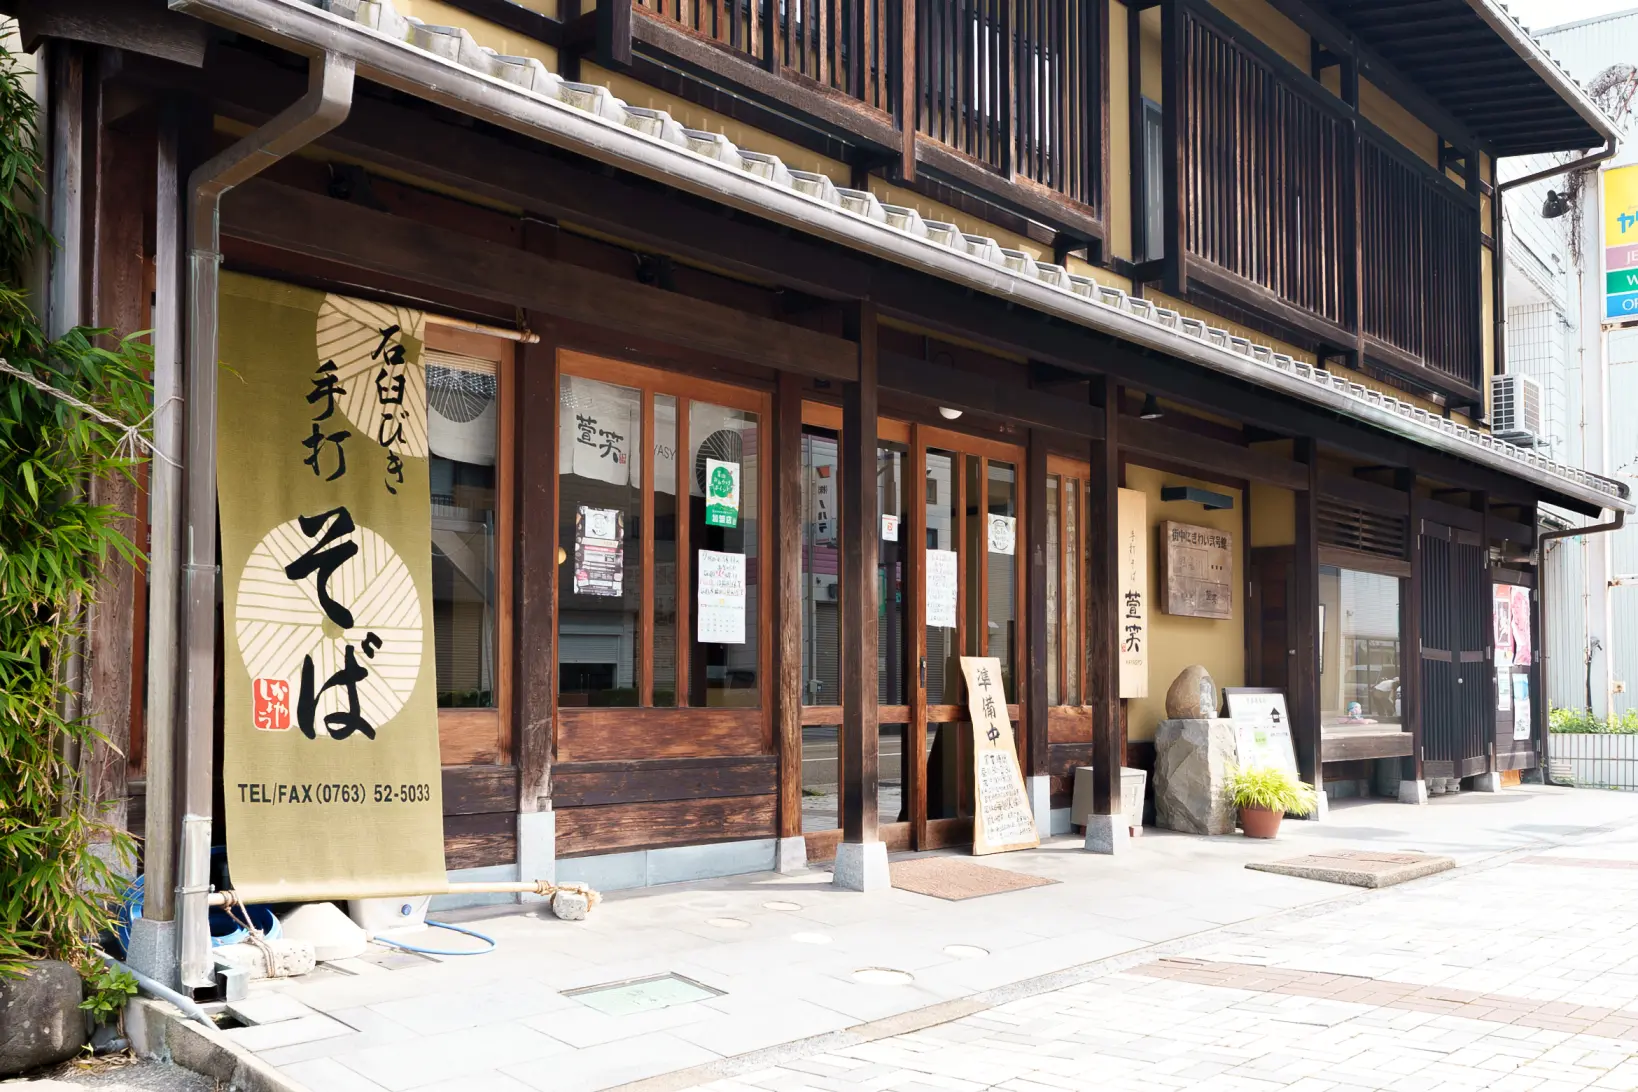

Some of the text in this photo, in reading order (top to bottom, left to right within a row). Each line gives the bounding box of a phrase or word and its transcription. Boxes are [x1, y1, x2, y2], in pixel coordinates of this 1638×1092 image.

[1617, 211, 1638, 233] ヤ
[371, 324, 407, 496] 石臼びき
[976, 667, 1001, 746] 準備中
[373, 784, 430, 803] 52-5033
